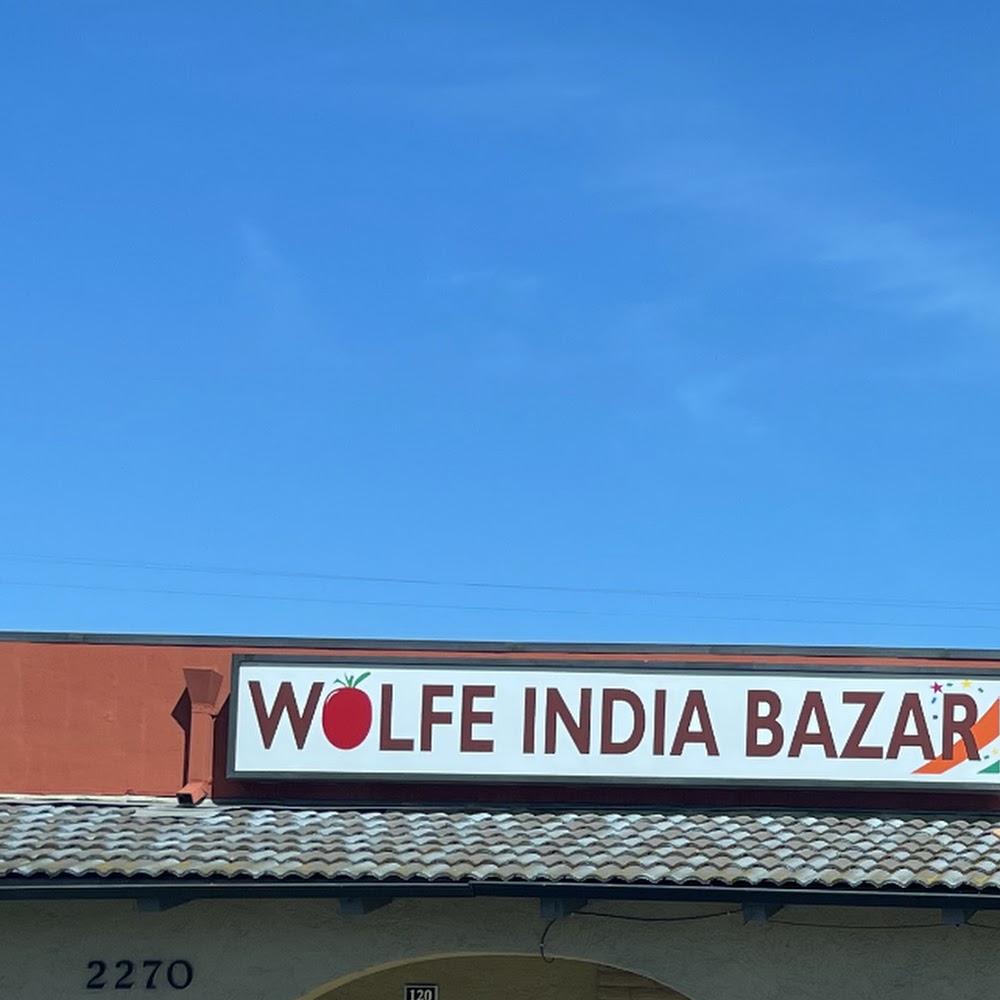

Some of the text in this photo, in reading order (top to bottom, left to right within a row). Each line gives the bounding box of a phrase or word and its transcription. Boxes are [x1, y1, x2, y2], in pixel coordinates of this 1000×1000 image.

[248, 680, 982, 761] WOLFE INDIA BAZAR
[86, 959, 194, 989] 2270
